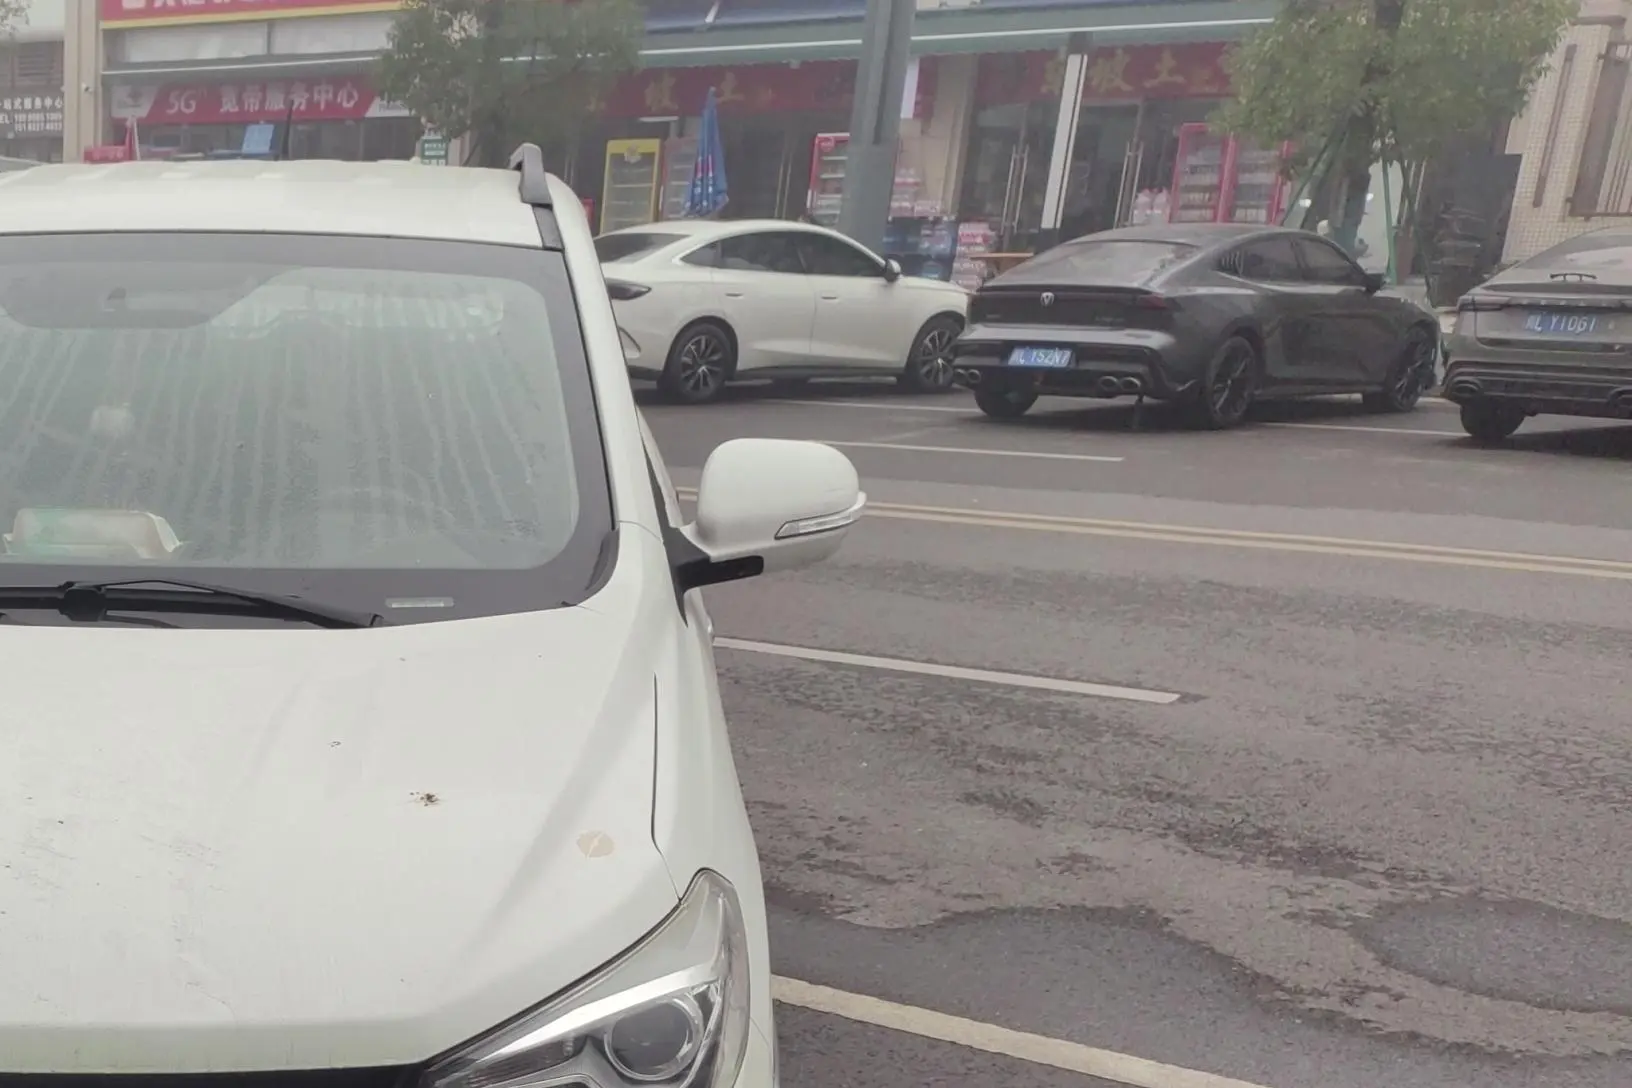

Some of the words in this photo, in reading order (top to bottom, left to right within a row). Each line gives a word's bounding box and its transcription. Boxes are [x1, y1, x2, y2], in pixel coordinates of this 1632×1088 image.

[219, 81, 360, 114] 宽带服务中心
